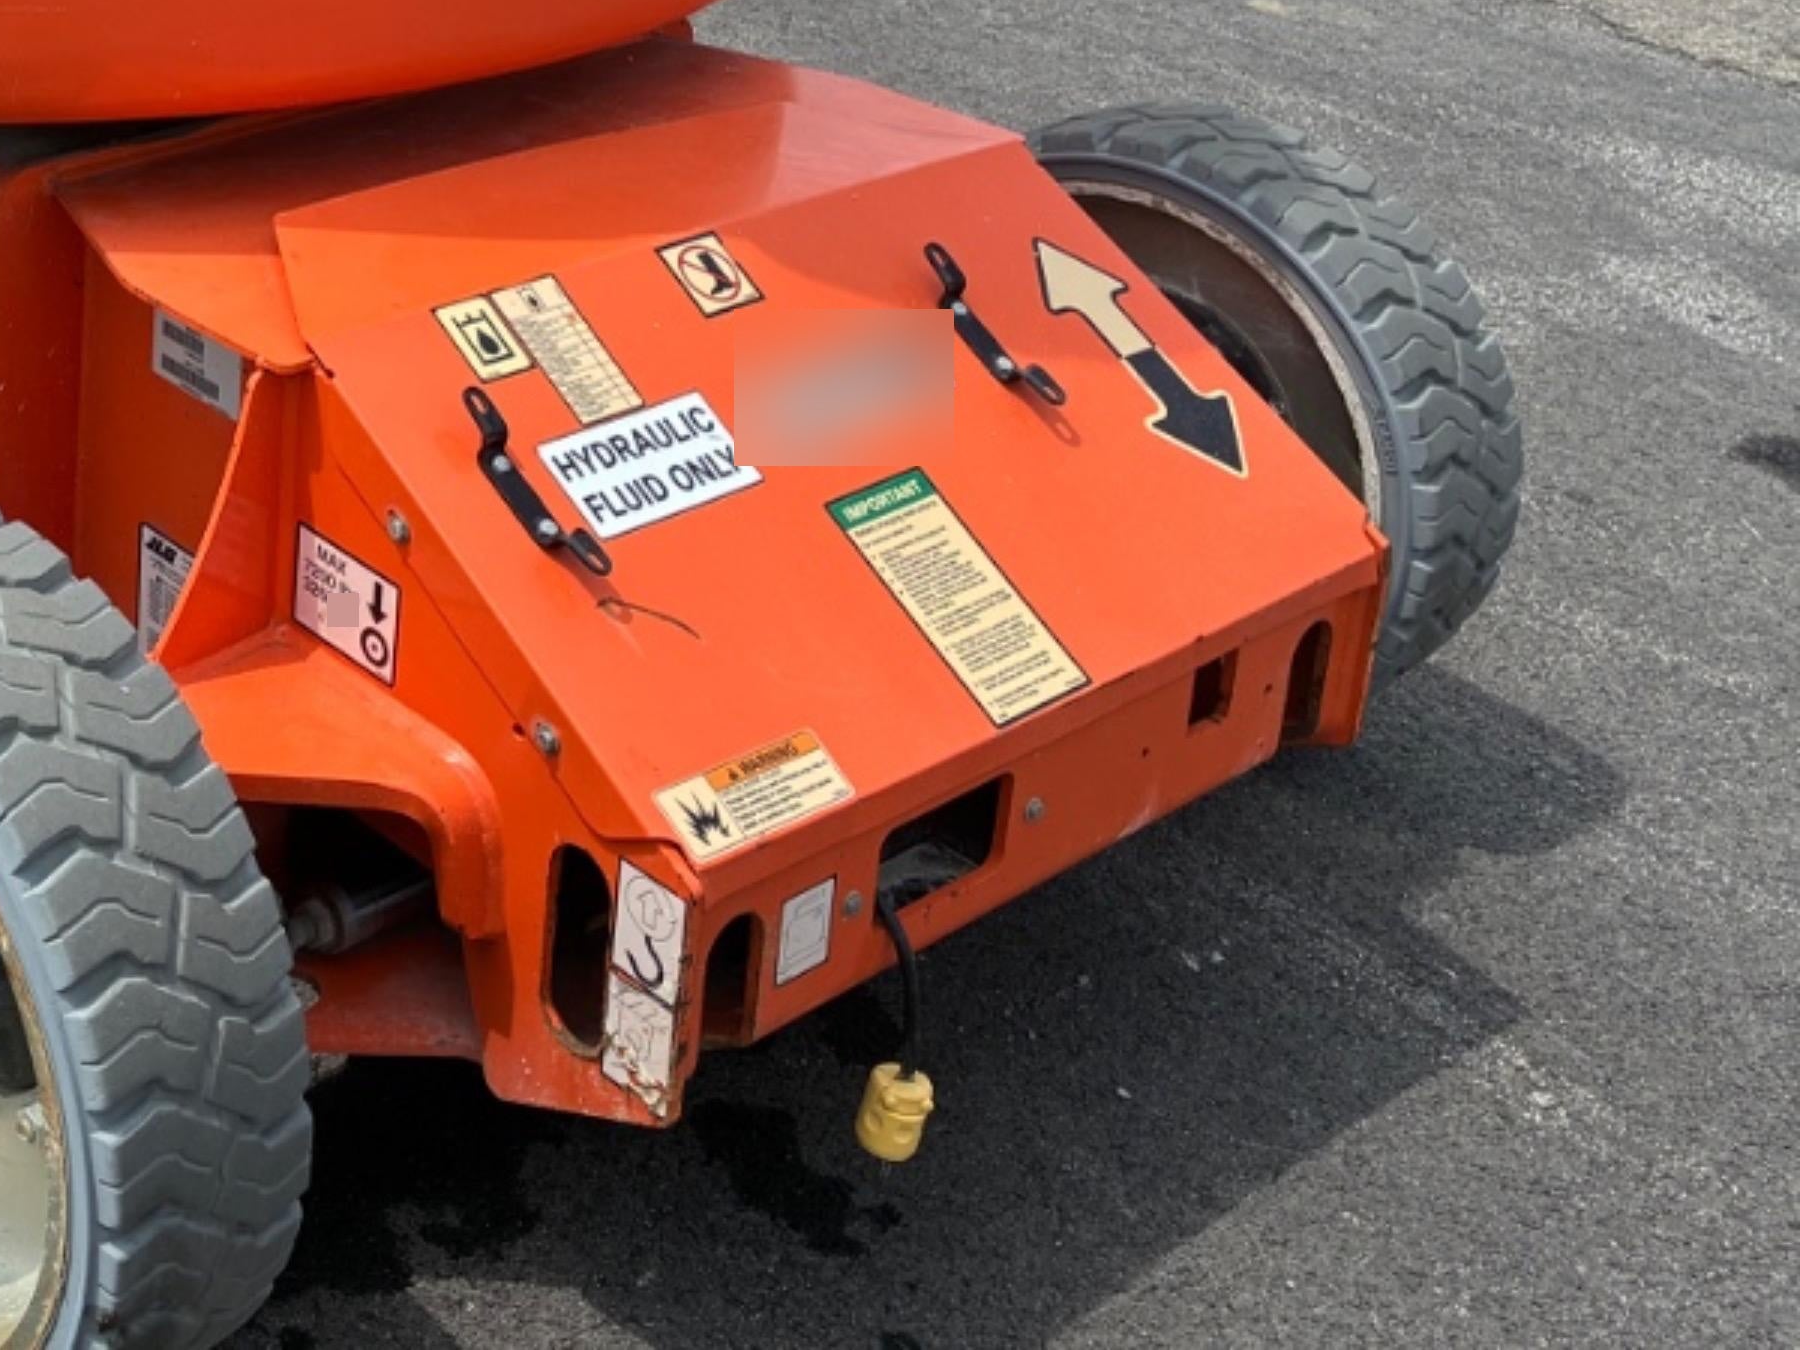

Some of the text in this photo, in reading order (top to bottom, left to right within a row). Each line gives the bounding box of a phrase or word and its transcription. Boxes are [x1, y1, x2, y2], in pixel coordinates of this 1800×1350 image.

[552, 406, 715, 482] HYDRAULIC
[582, 473, 670, 523] FLUID
[841, 478, 922, 523] IMPORTANT
[317, 542, 346, 576] MAX
